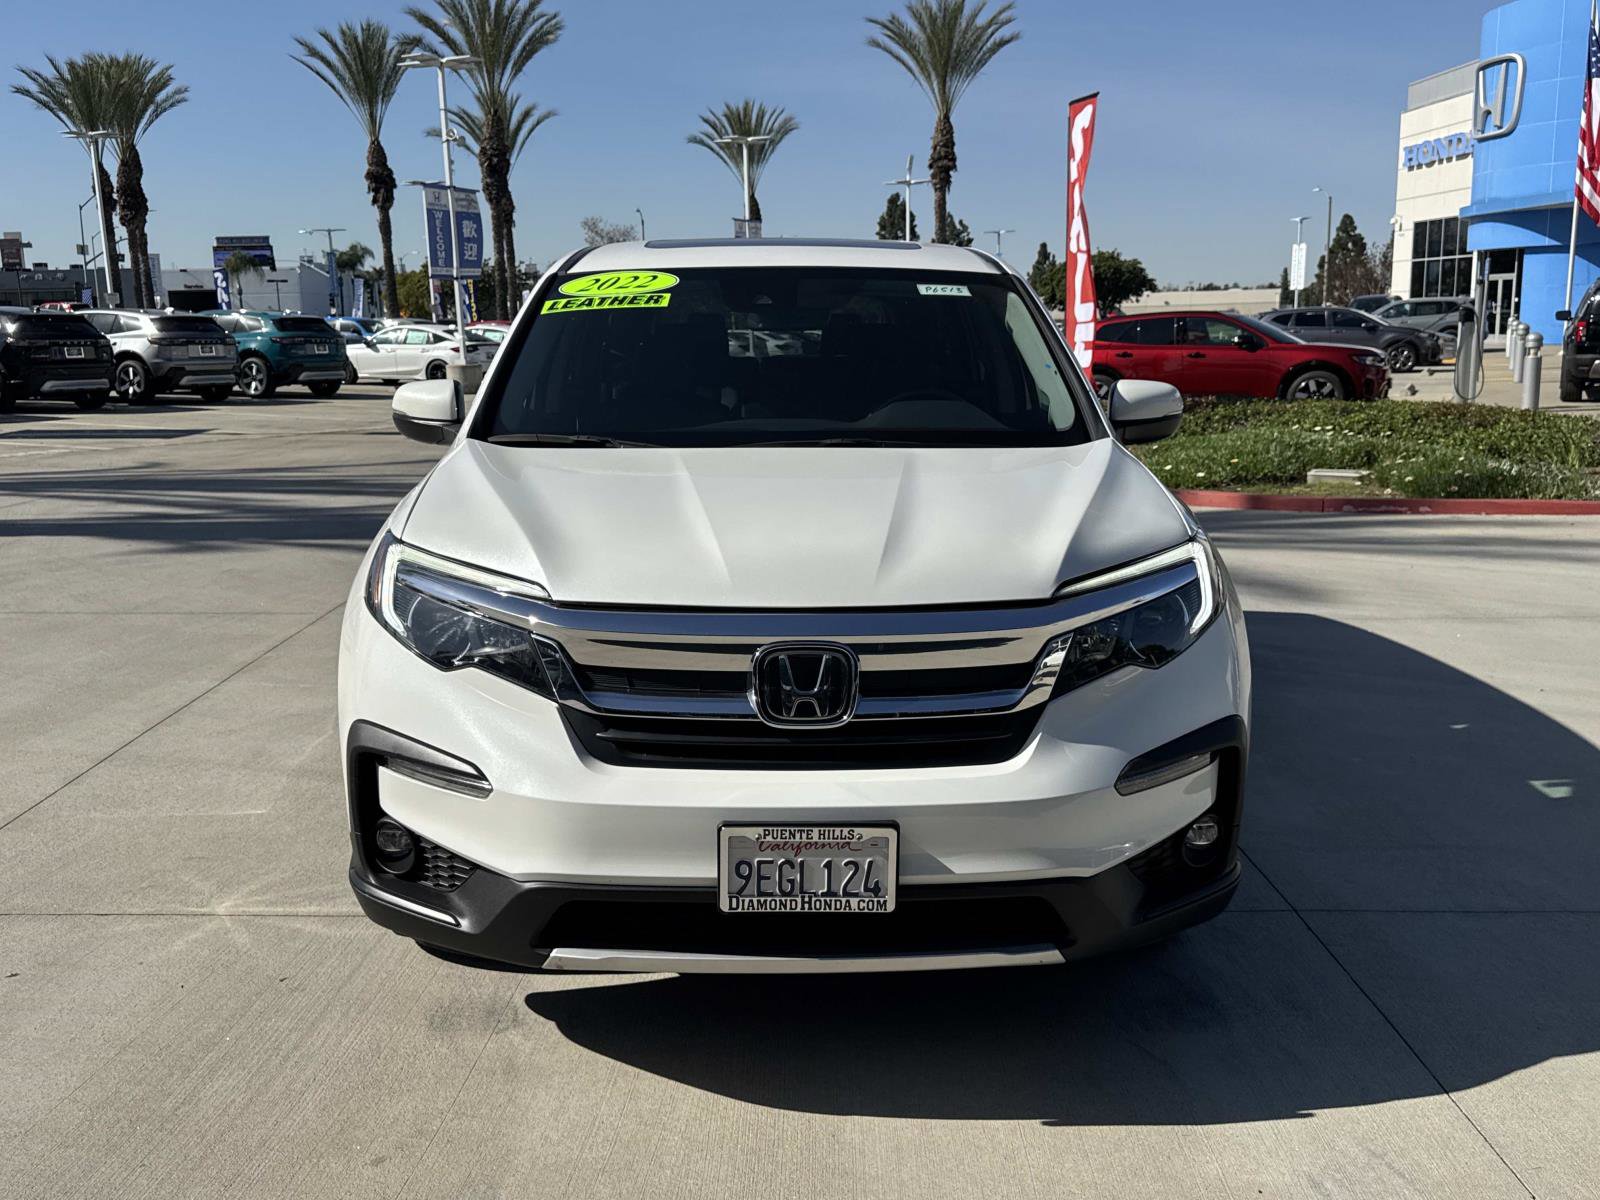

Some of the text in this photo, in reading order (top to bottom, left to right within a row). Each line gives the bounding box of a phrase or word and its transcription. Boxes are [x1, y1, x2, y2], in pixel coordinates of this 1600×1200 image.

[432, 210, 447, 267] WELCOME
[575, 274, 659, 293] 2022
[547, 294, 664, 311] LEATHER
[762, 828, 856, 840] PUENTE HILLS
[758, 841, 863, 857] California
[734, 858, 882, 897] 9EGL124
